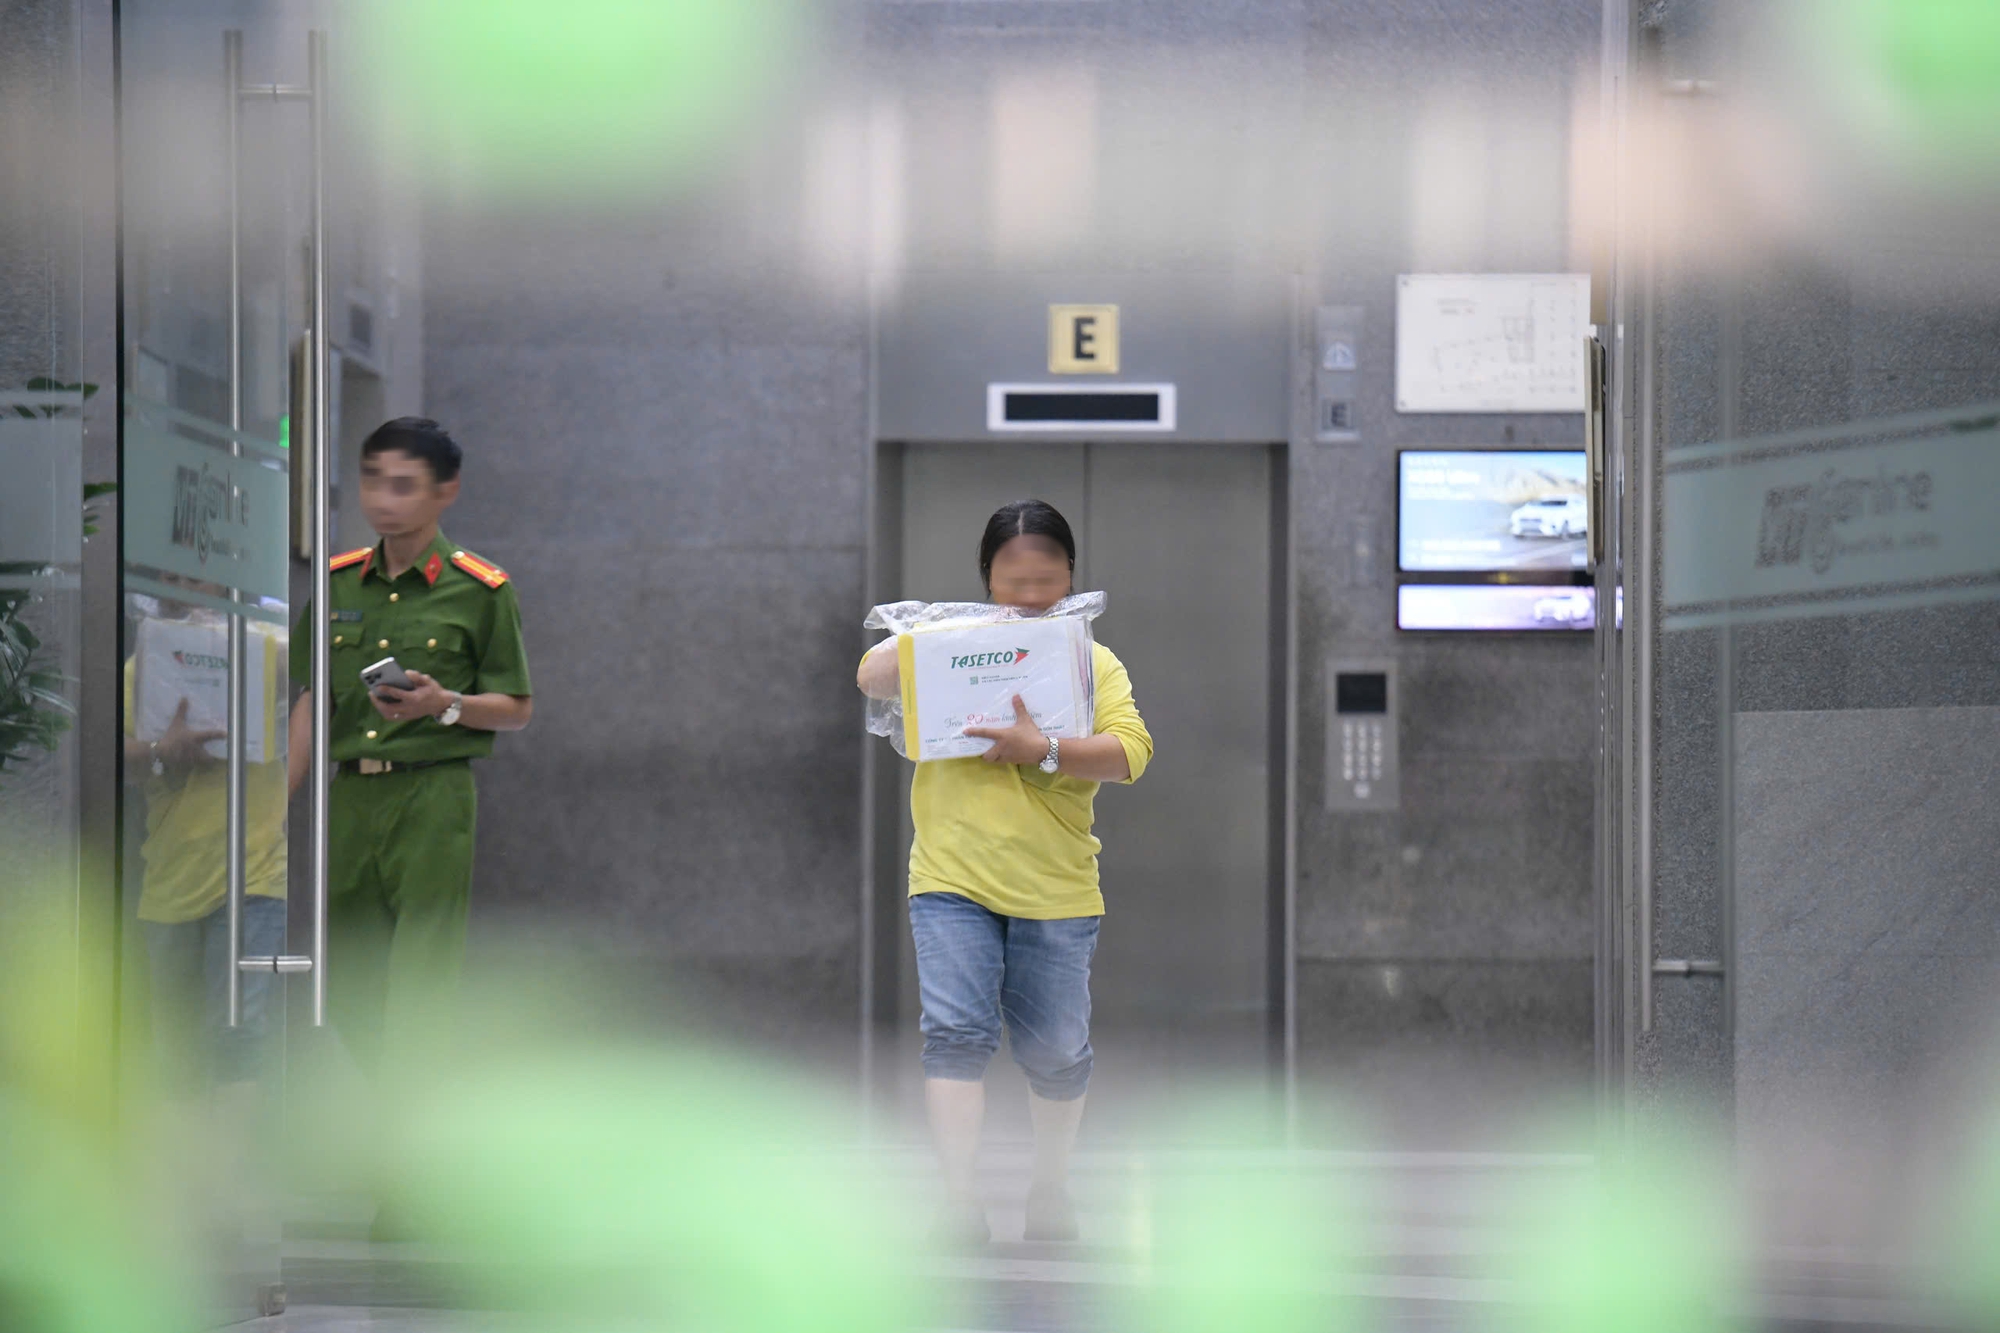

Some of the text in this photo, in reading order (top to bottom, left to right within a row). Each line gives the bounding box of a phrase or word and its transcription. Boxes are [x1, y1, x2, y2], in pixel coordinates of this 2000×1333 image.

[1073, 317, 1097, 360] E
[1330, 401, 1348, 428] E
[950, 650, 1014, 669] TASETCO
[966, 712, 984, 725] 20
